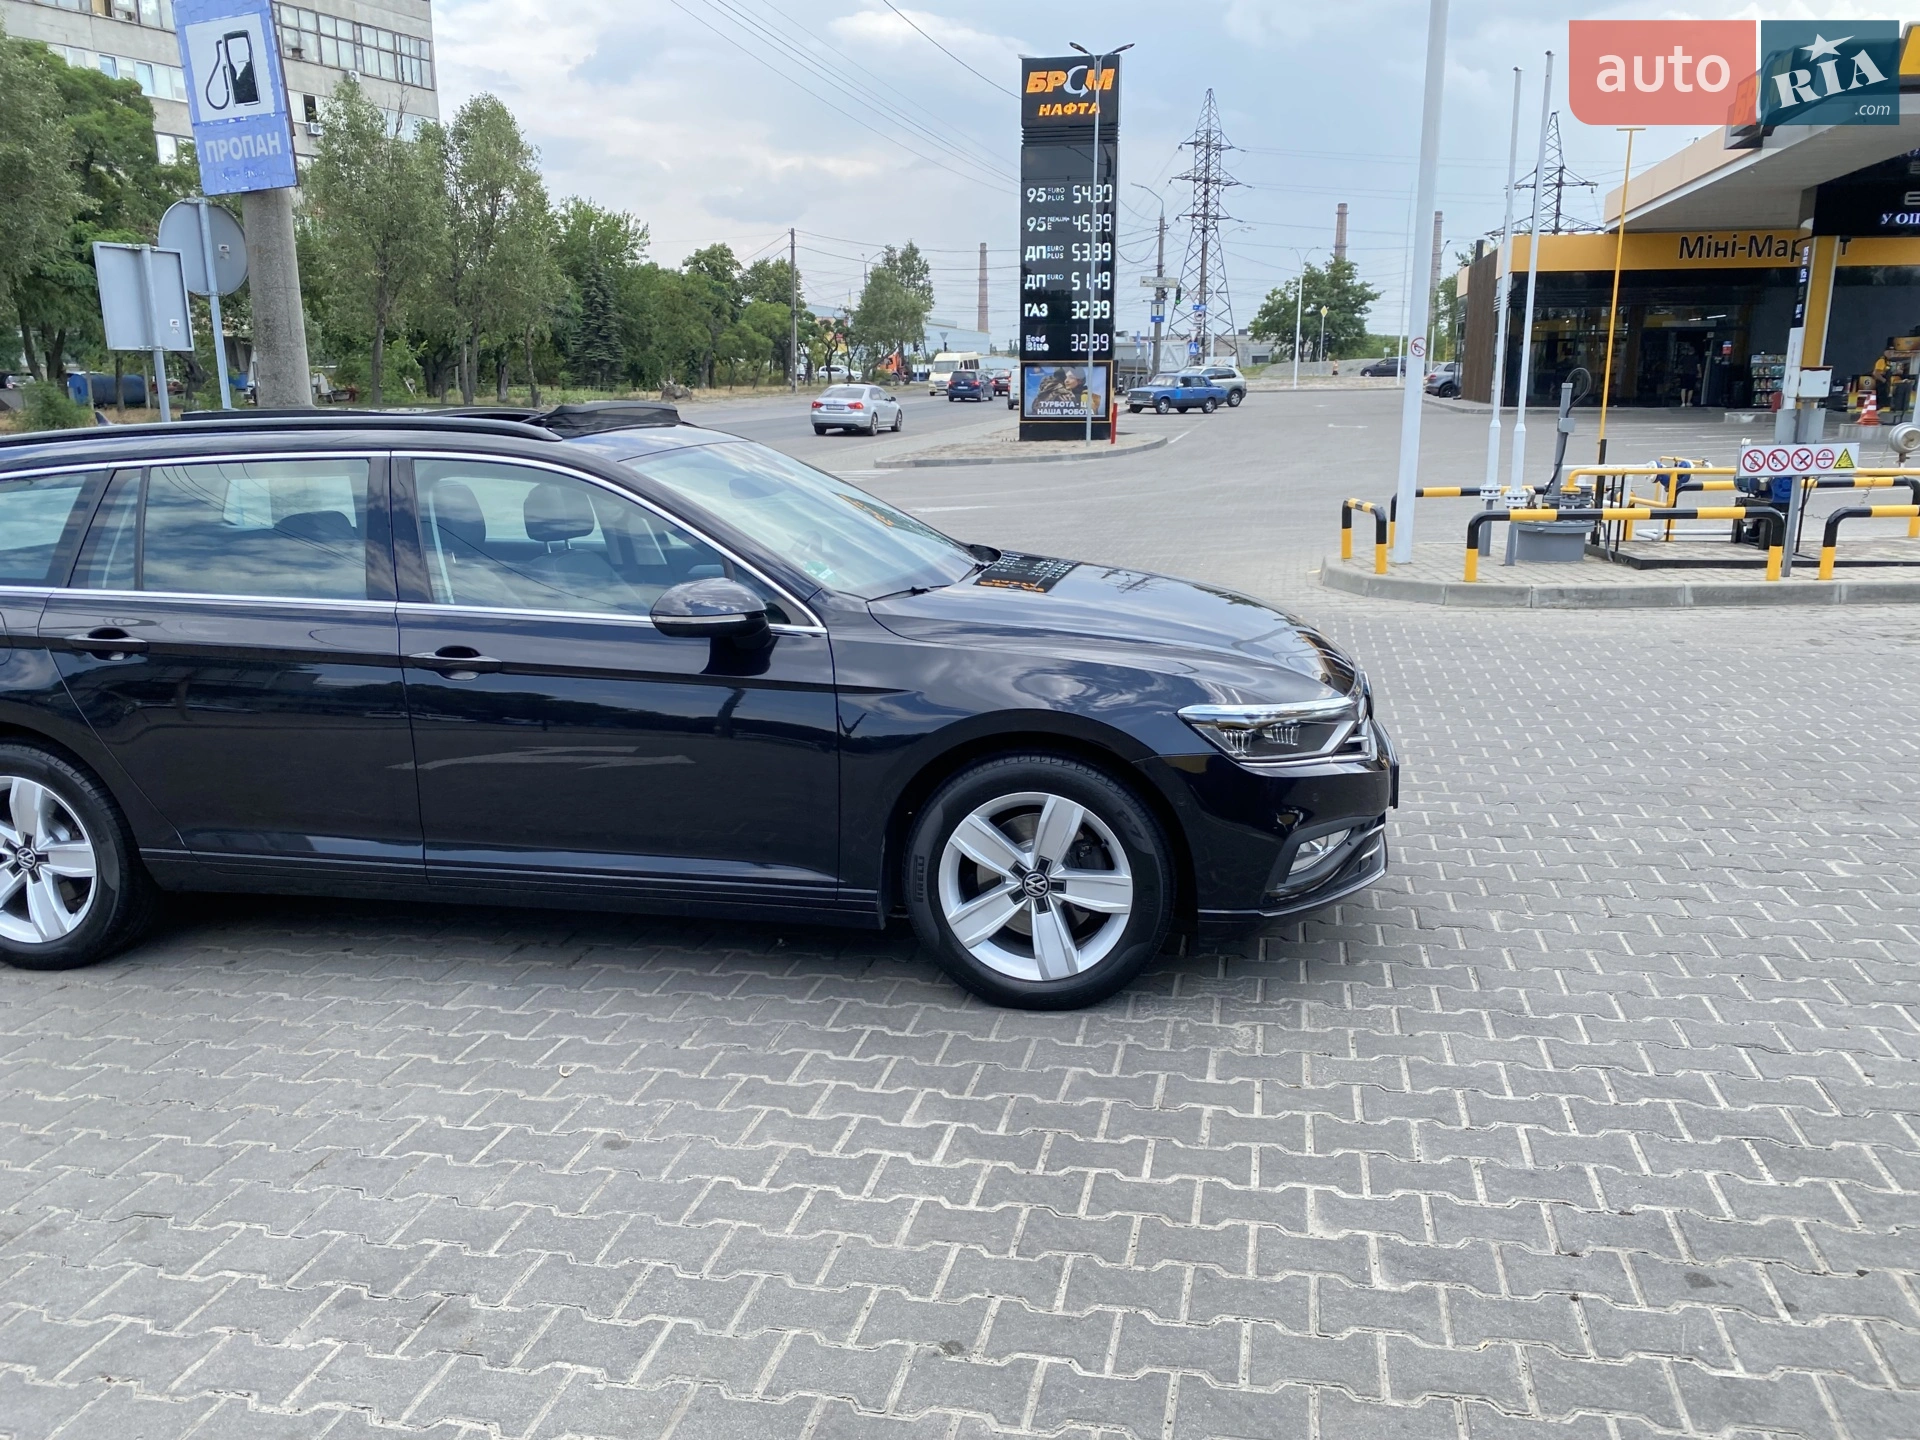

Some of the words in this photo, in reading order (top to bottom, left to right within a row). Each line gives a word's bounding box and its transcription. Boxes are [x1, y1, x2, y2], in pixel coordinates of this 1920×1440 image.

[1026, 65, 1115, 98] БРСМ
[1038, 102, 1101, 116] НАФТА
[204, 131, 282, 163] ПРОПАН
[1026, 187, 1047, 203] 95
[1026, 216, 1047, 232] 95
[1047, 222, 1052, 230] E
[1024, 245, 1047, 262] ДП
[1679, 234, 1850, 263] Міні-Март
[1024, 274, 1046, 290] ДП
[1024, 302, 1049, 317] ГАЗ
